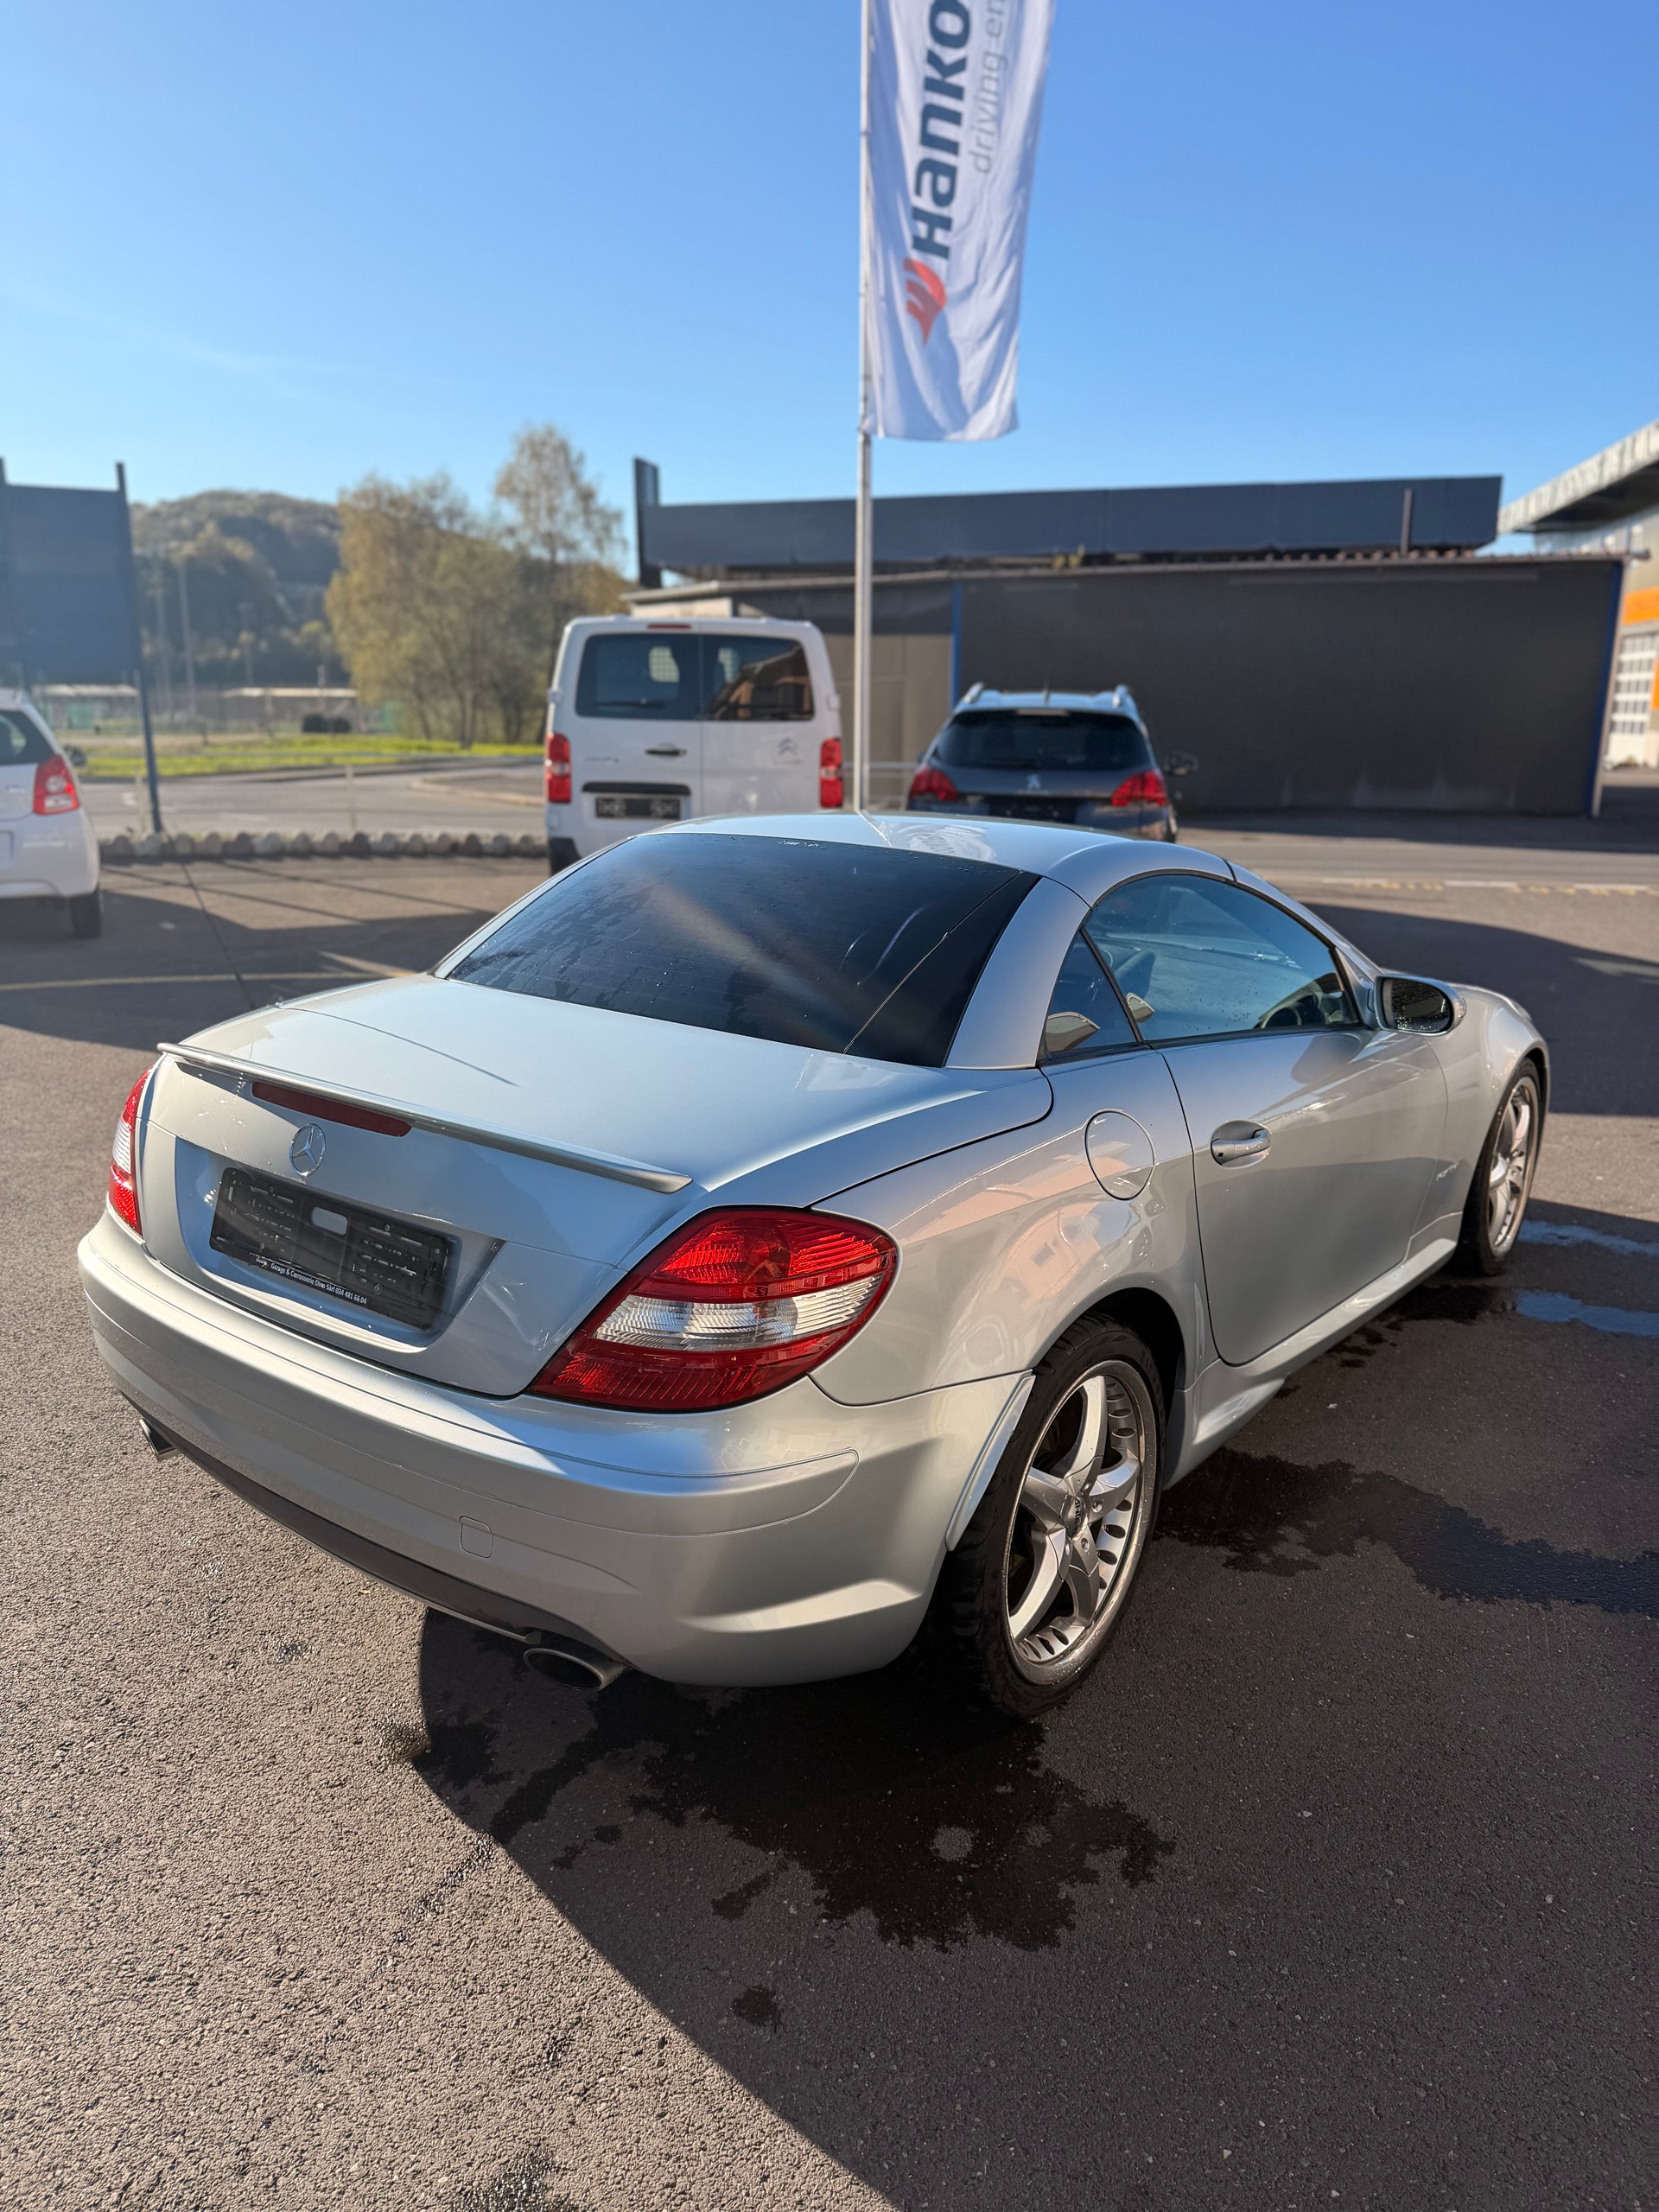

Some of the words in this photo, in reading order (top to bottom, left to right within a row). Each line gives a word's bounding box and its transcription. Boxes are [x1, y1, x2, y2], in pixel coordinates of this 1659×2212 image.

[910, 0, 972, 261] Hanko
[968, 51, 1008, 175] driving
[270, 1262, 286, 1274] Garage
[290, 1270, 315, 1286] Carrosserie
[315, 1279, 326, 1288] Dino
[335, 1287, 344, 1296] 024
[345, 1291, 353, 1300] 481
